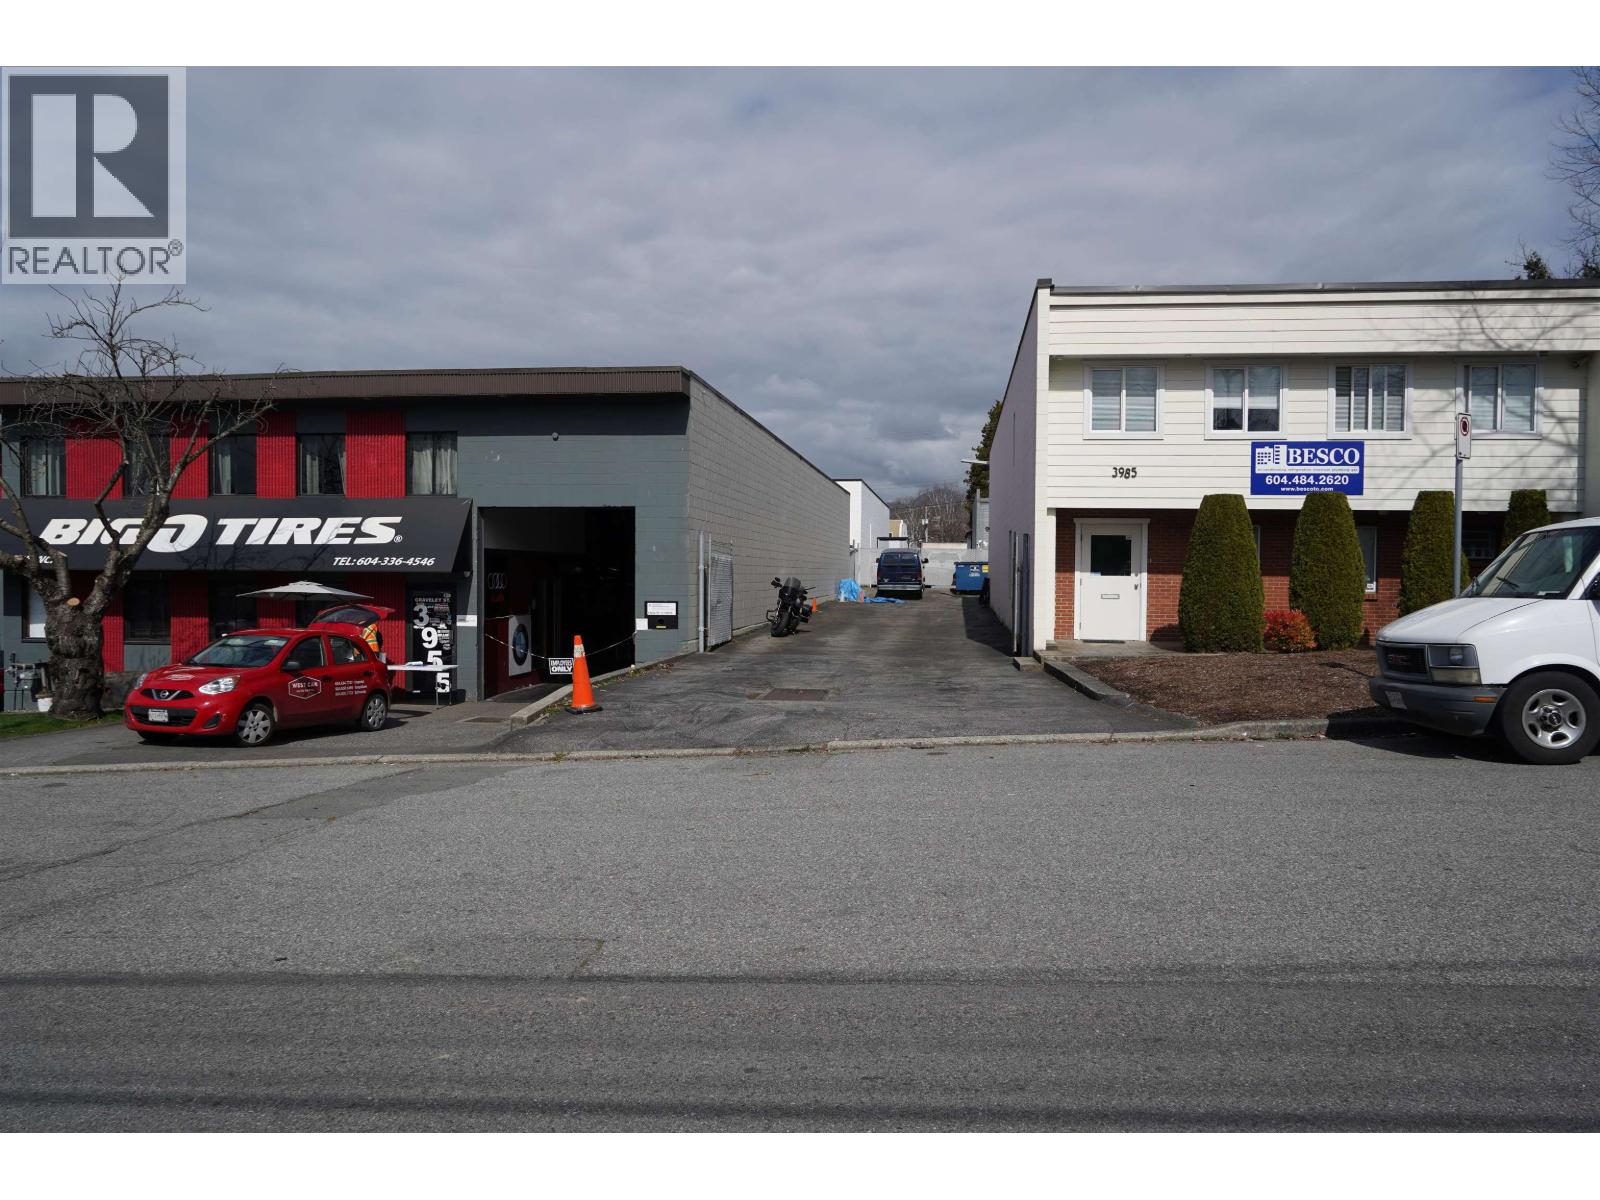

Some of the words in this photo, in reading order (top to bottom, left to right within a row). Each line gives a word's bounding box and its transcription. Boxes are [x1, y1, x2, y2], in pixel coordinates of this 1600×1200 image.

[1287, 447, 1360, 465] BESCO
[1112, 466, 1137, 479] 3985
[1265, 475, 1349, 485] 604.484.2620
[356, 556, 436, 566] 604-336-4546
[551, 665, 573, 673] ONLY
